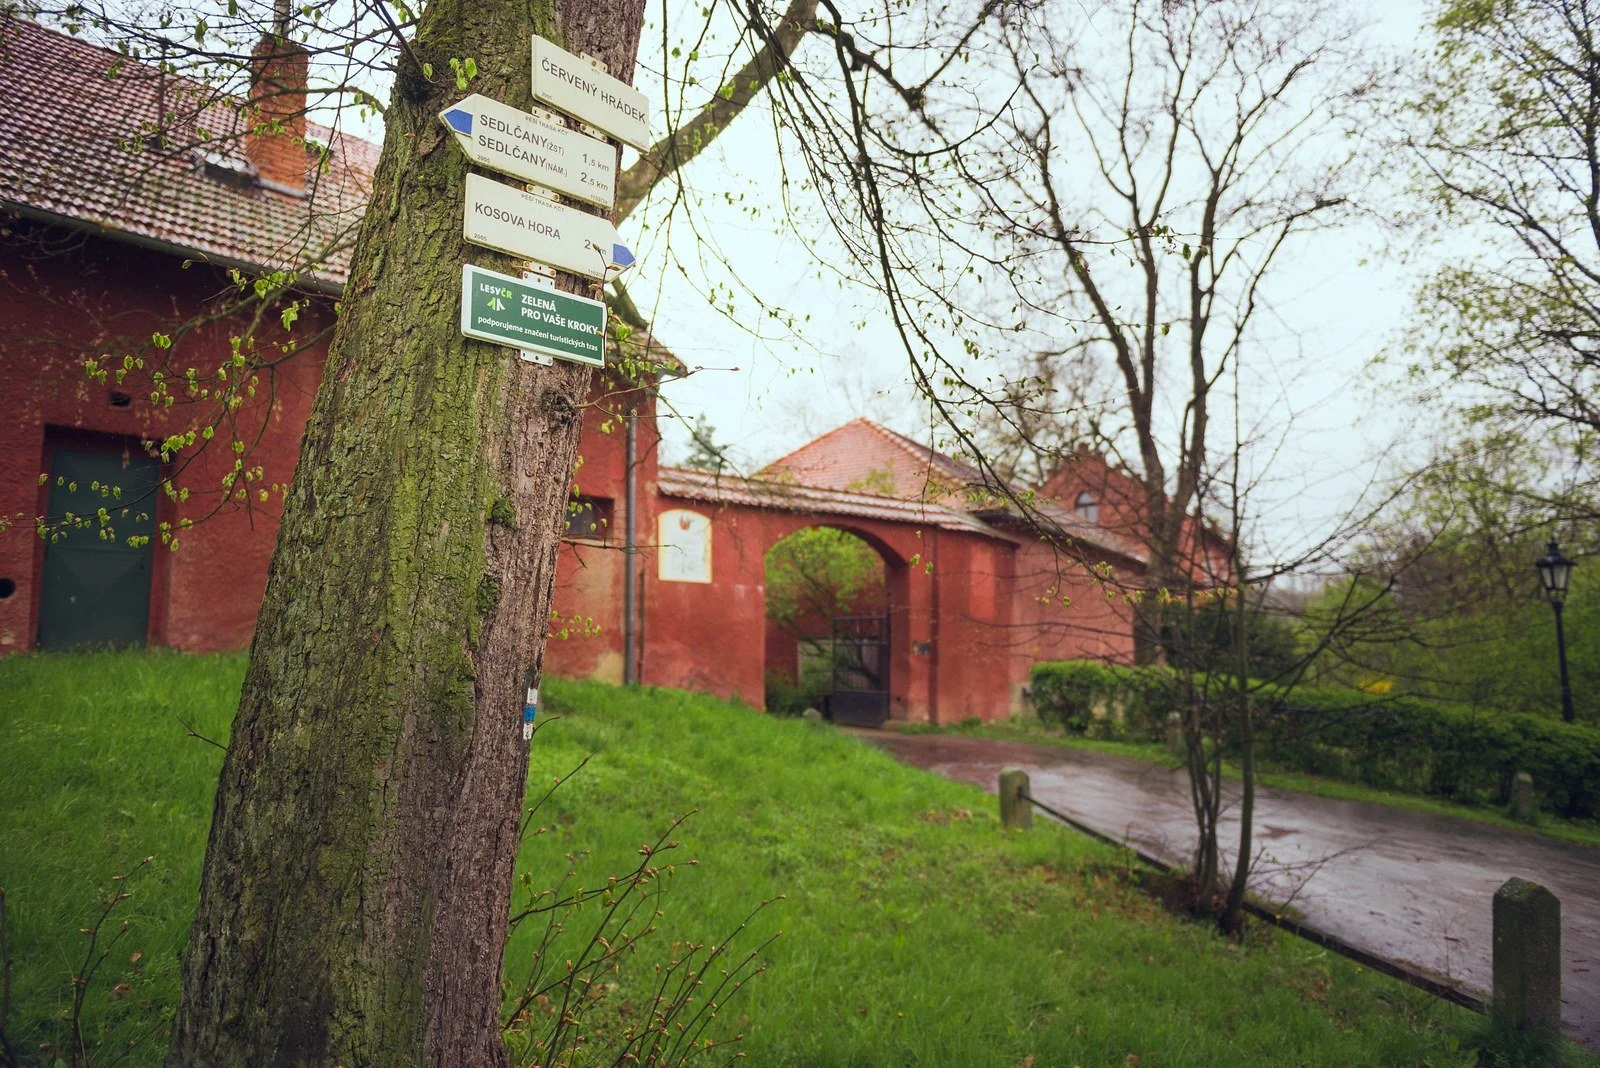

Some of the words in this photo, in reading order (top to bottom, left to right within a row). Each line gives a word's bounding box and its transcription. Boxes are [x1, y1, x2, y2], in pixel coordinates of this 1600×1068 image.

[541, 57, 598, 96] ČERVENÝ
[601, 90, 646, 124] HRÁDEK
[539, 121, 557, 132] TRASA
[597, 161, 610, 171] km
[596, 180, 608, 191] km
[535, 199, 552, 208] TRASA
[475, 202, 525, 228] KOSOVA
[528, 219, 561, 240] HORA
[521, 294, 557, 312] ZELENÁ
[521, 307, 541, 321] PRO
[542, 312, 566, 327] VAŠE
[568, 319, 598, 335] KROKY
[477, 316, 523, 333] podporujeme
[524, 328, 550, 340] značení
[550, 333, 586, 349] turistických
[586, 342, 598, 352] tras
